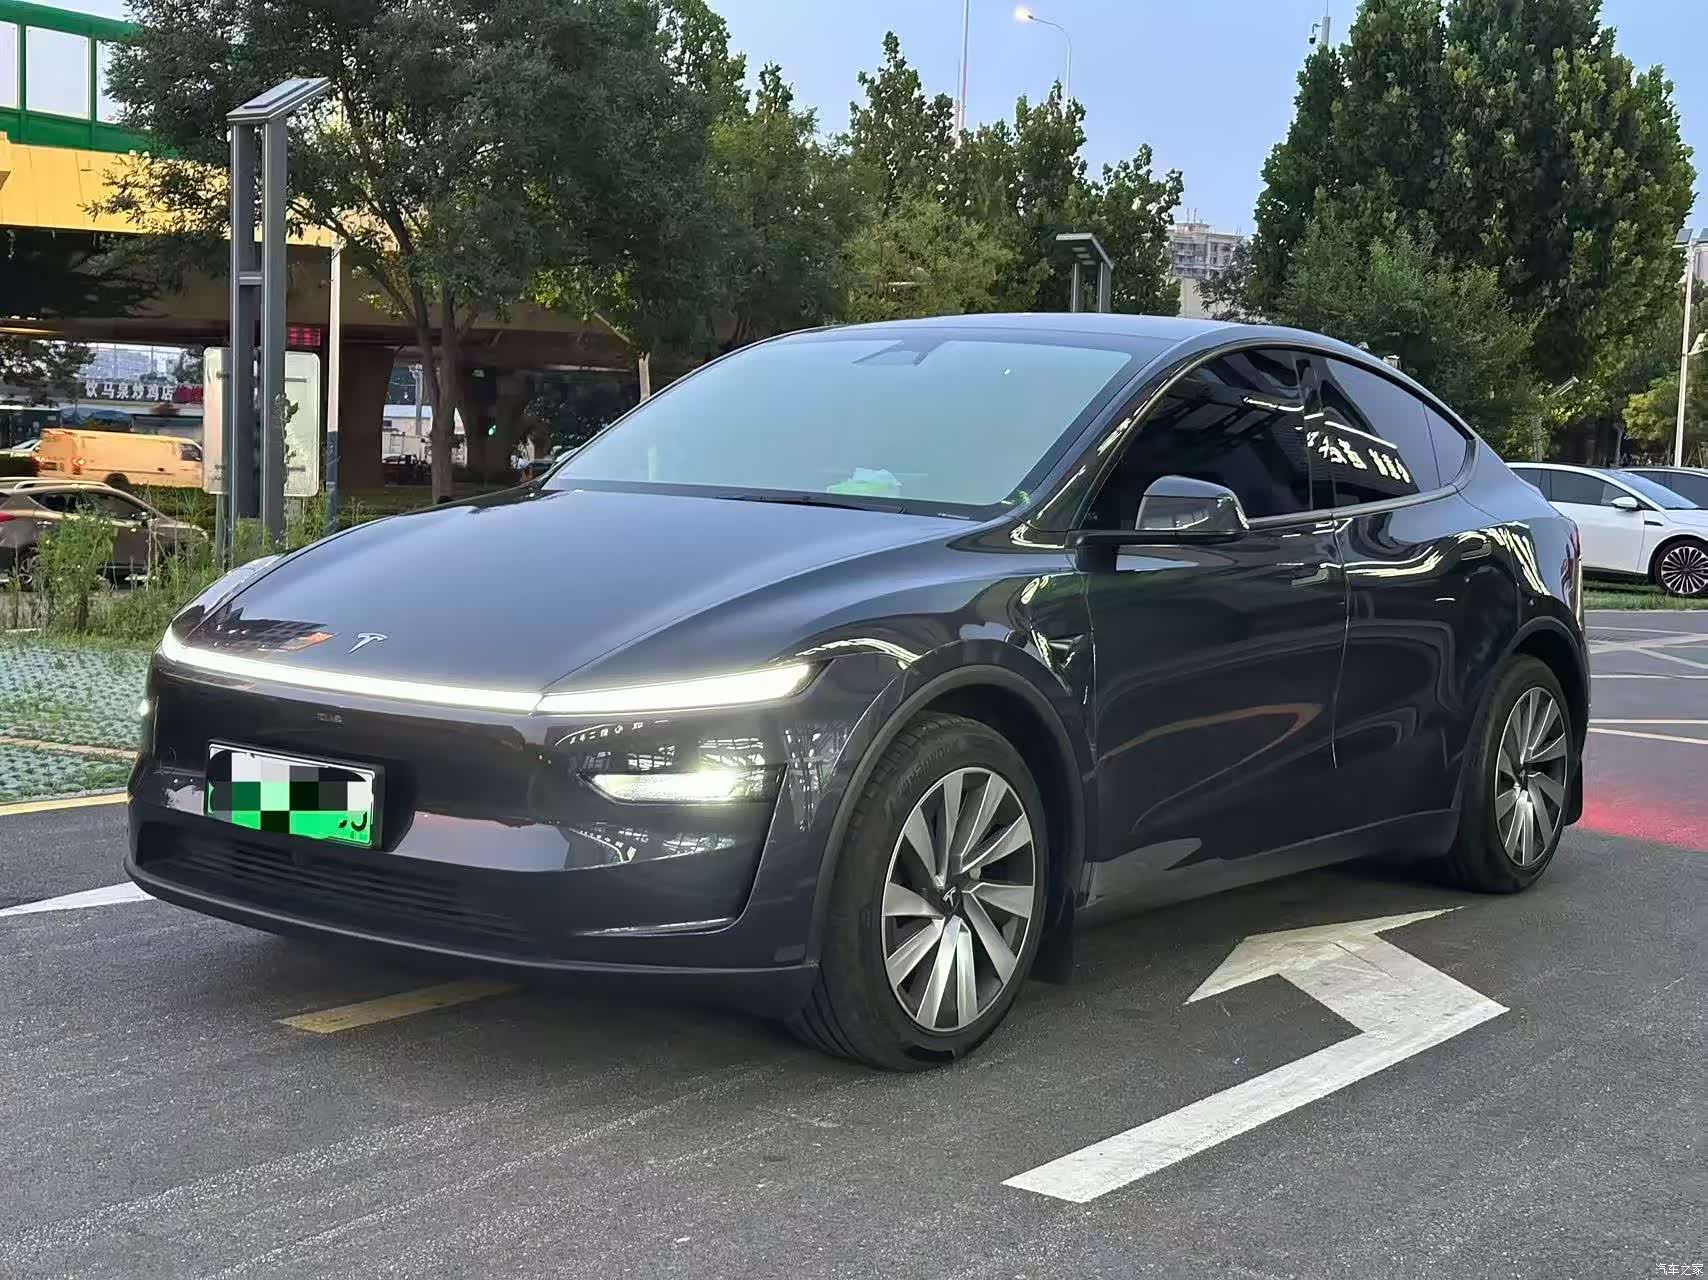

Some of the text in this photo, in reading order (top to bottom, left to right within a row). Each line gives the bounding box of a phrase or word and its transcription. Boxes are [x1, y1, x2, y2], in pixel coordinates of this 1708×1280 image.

[85, 380, 175, 401] 饮马泉炒鸡店
